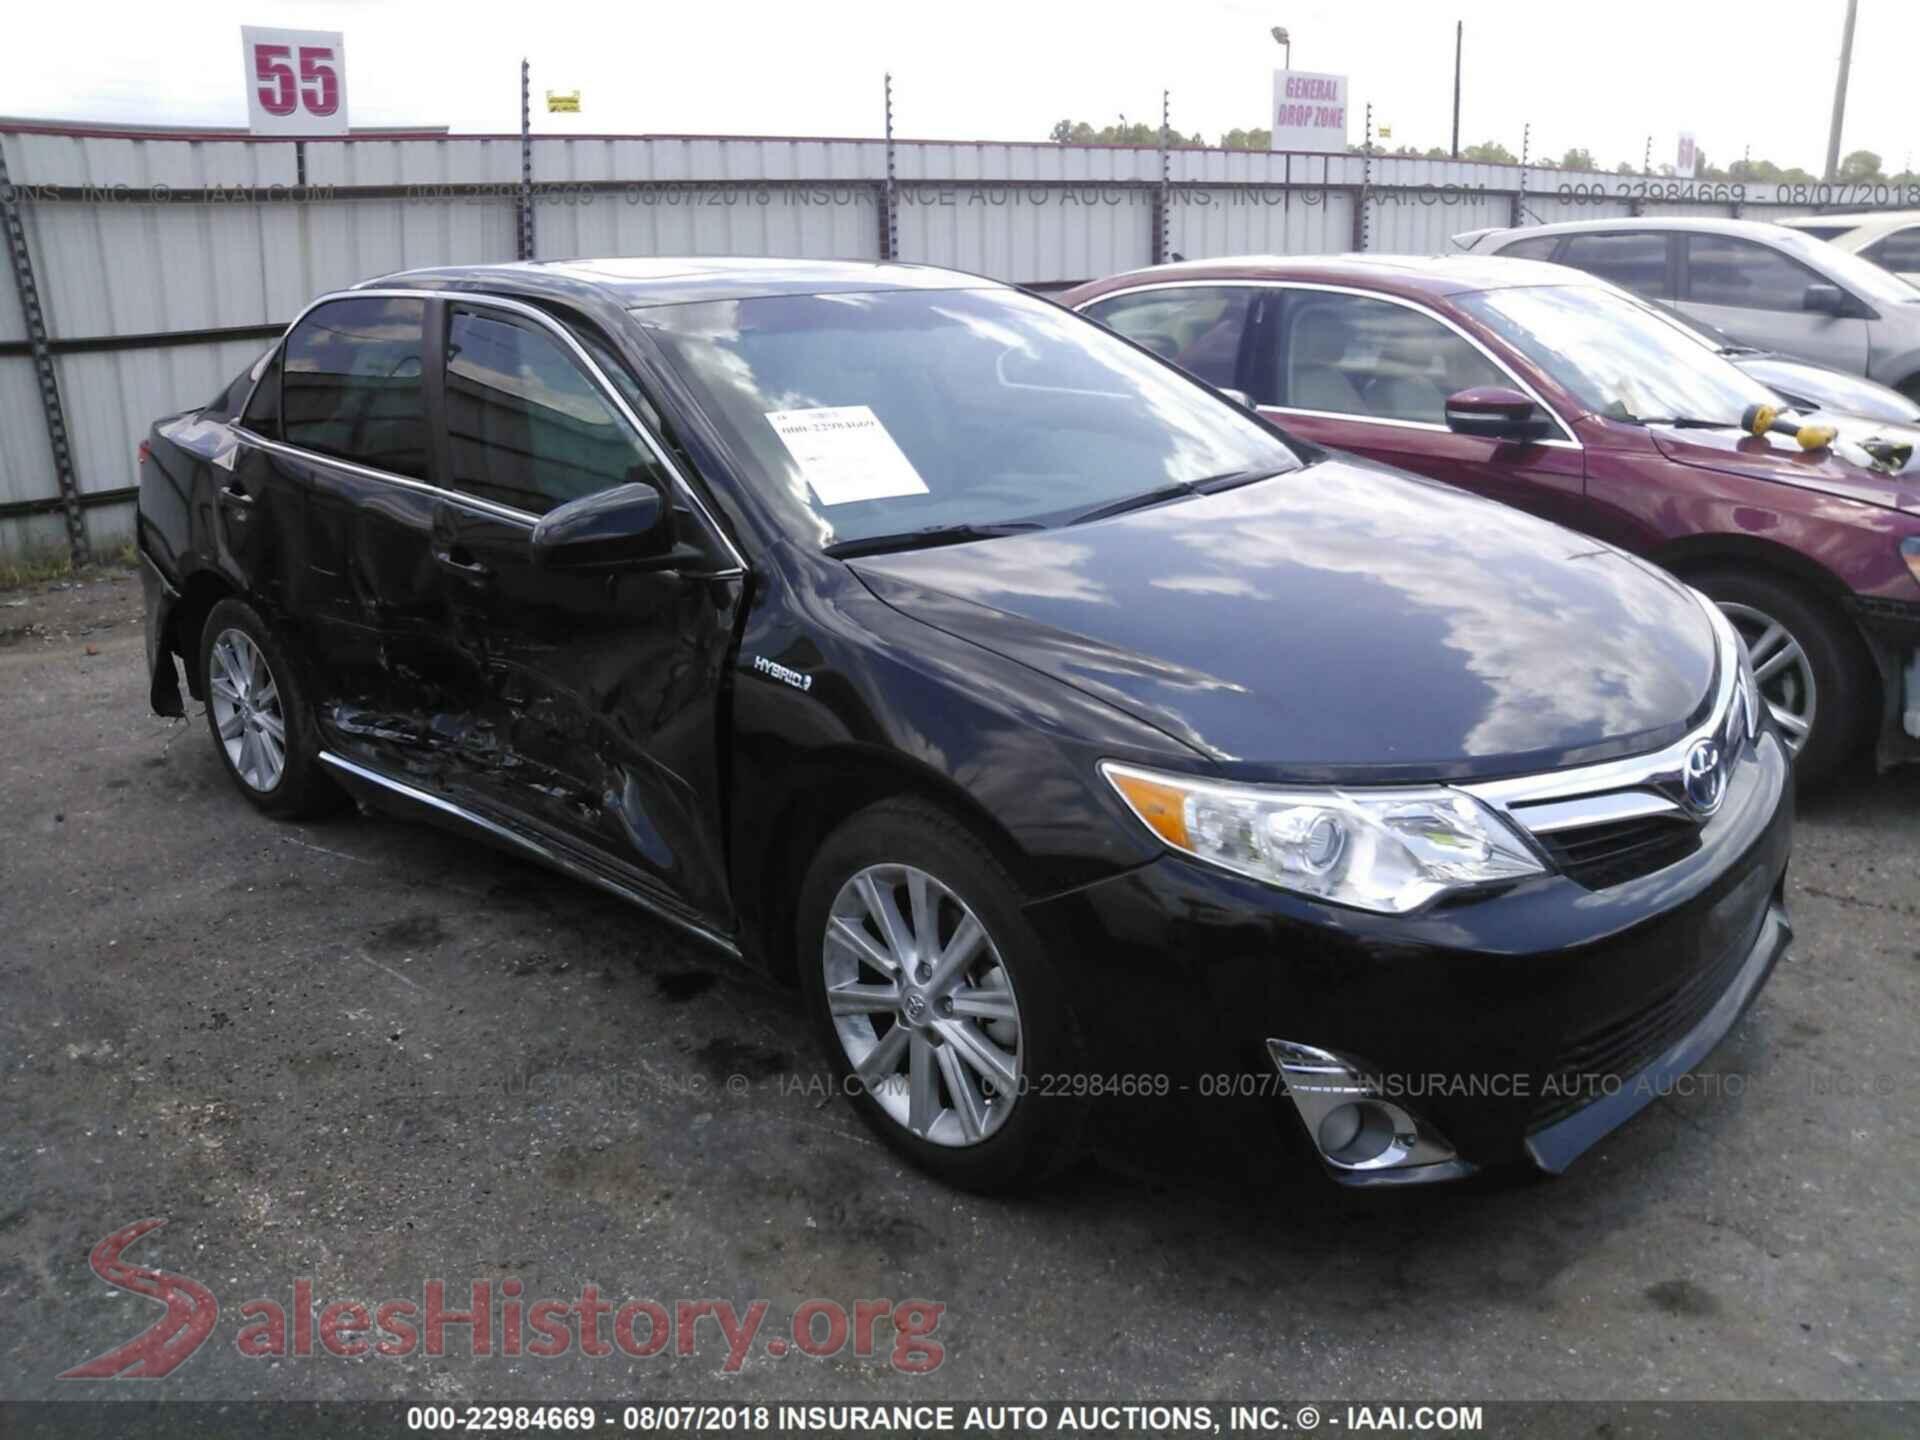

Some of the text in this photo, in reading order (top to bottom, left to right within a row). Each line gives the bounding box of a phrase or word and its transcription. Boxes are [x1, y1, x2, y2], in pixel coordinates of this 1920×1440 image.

[254, 44, 339, 117] 55
[1286, 76, 1338, 101] GENERAL
[1278, 103, 1344, 128] DROP ZONE
[754, 655, 803, 688] HYBRID
